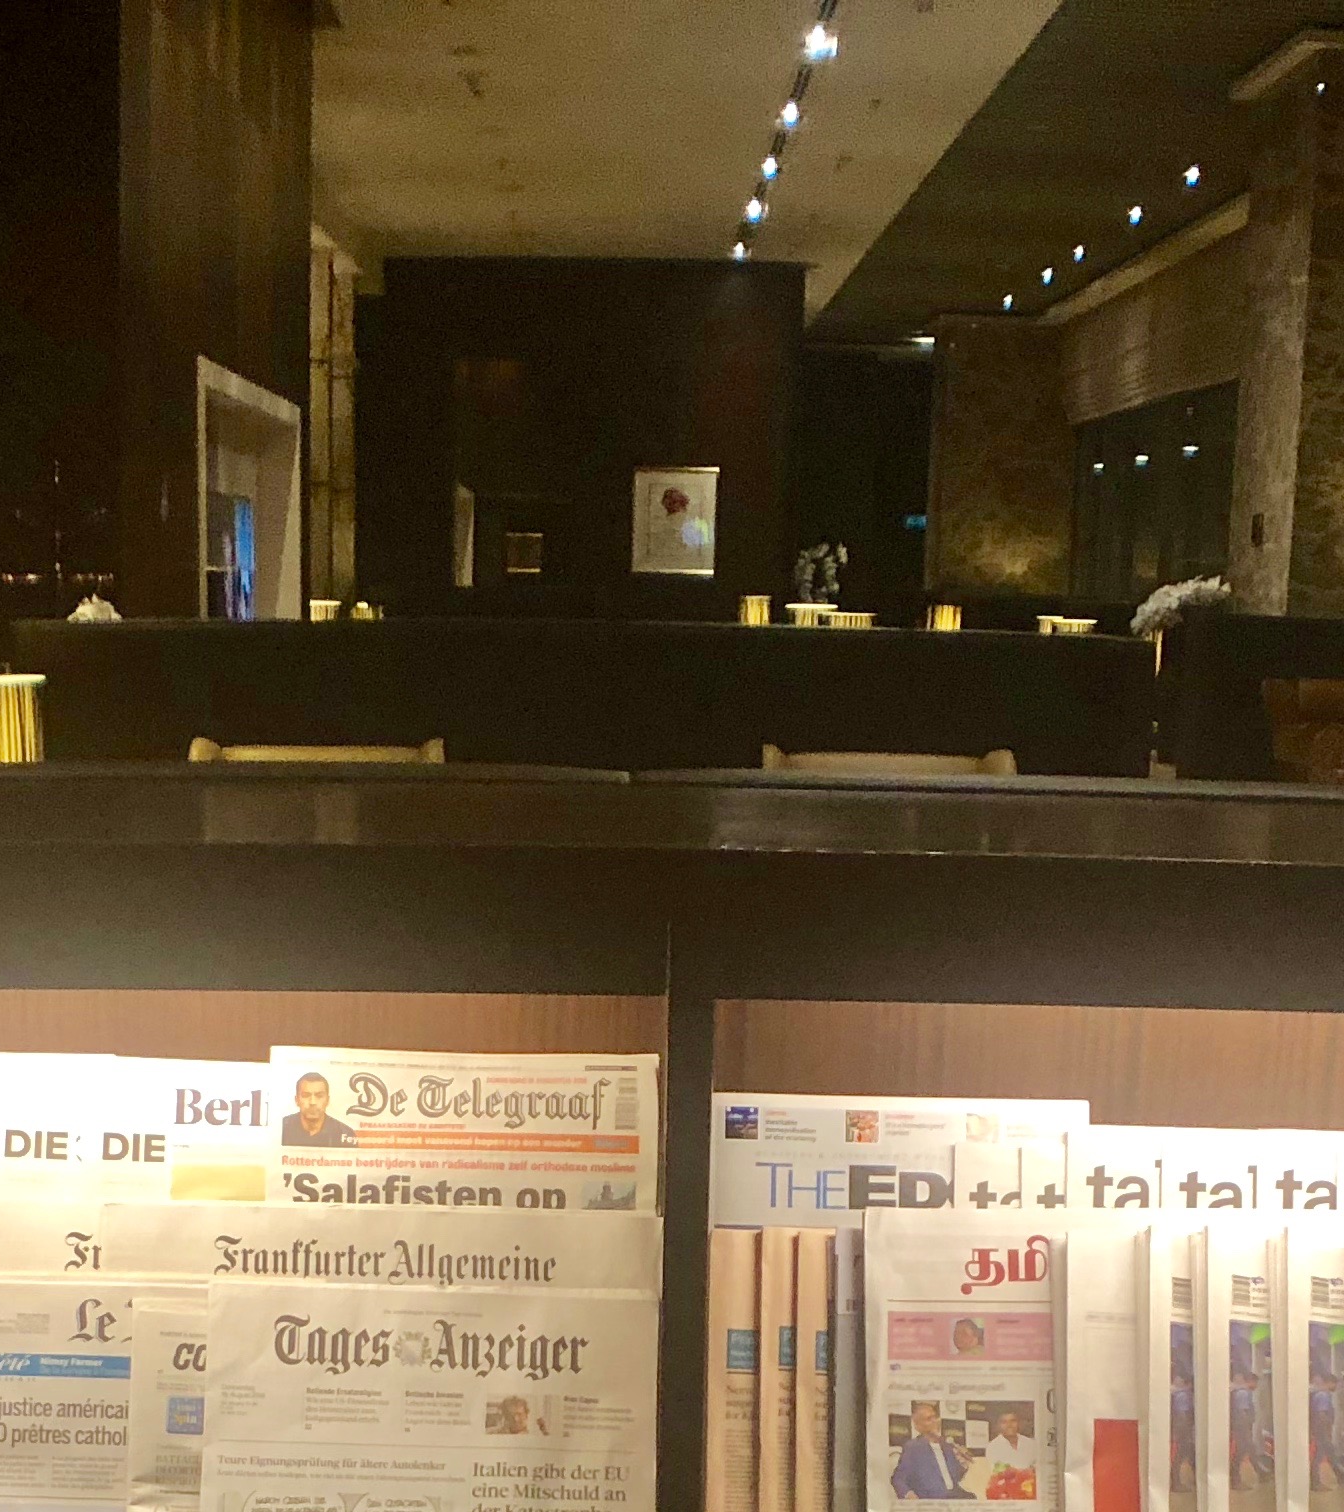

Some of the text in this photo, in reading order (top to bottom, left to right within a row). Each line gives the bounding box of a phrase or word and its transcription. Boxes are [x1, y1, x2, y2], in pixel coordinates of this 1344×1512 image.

[346, 1072, 613, 1131] De Telegraaf
[3, 1129, 69, 1161] DIE
[102, 1132, 166, 1163] DIE
[419, 1159, 439, 1169] van
[755, 1162, 848, 1211] THE
[213, 1235, 557, 1286] Frankfurter Allgemeine
[273, 1313, 591, 1382] Tages Anzeiger
[56, 1398, 130, 1420] américai
[10, 1423, 71, 1448] prêtres
[74, 1426, 127, 1447] cathol
[217, 1454, 246, 1467] Teure
[341, 1457, 358, 1469] für
[471, 1462, 529, 1479] Italien
[531, 1463, 567, 1484] gibt
[570, 1465, 600, 1481] der
[603, 1467, 630, 1483] EU
[471, 1484, 627, 1503] eine Mitschuld an
